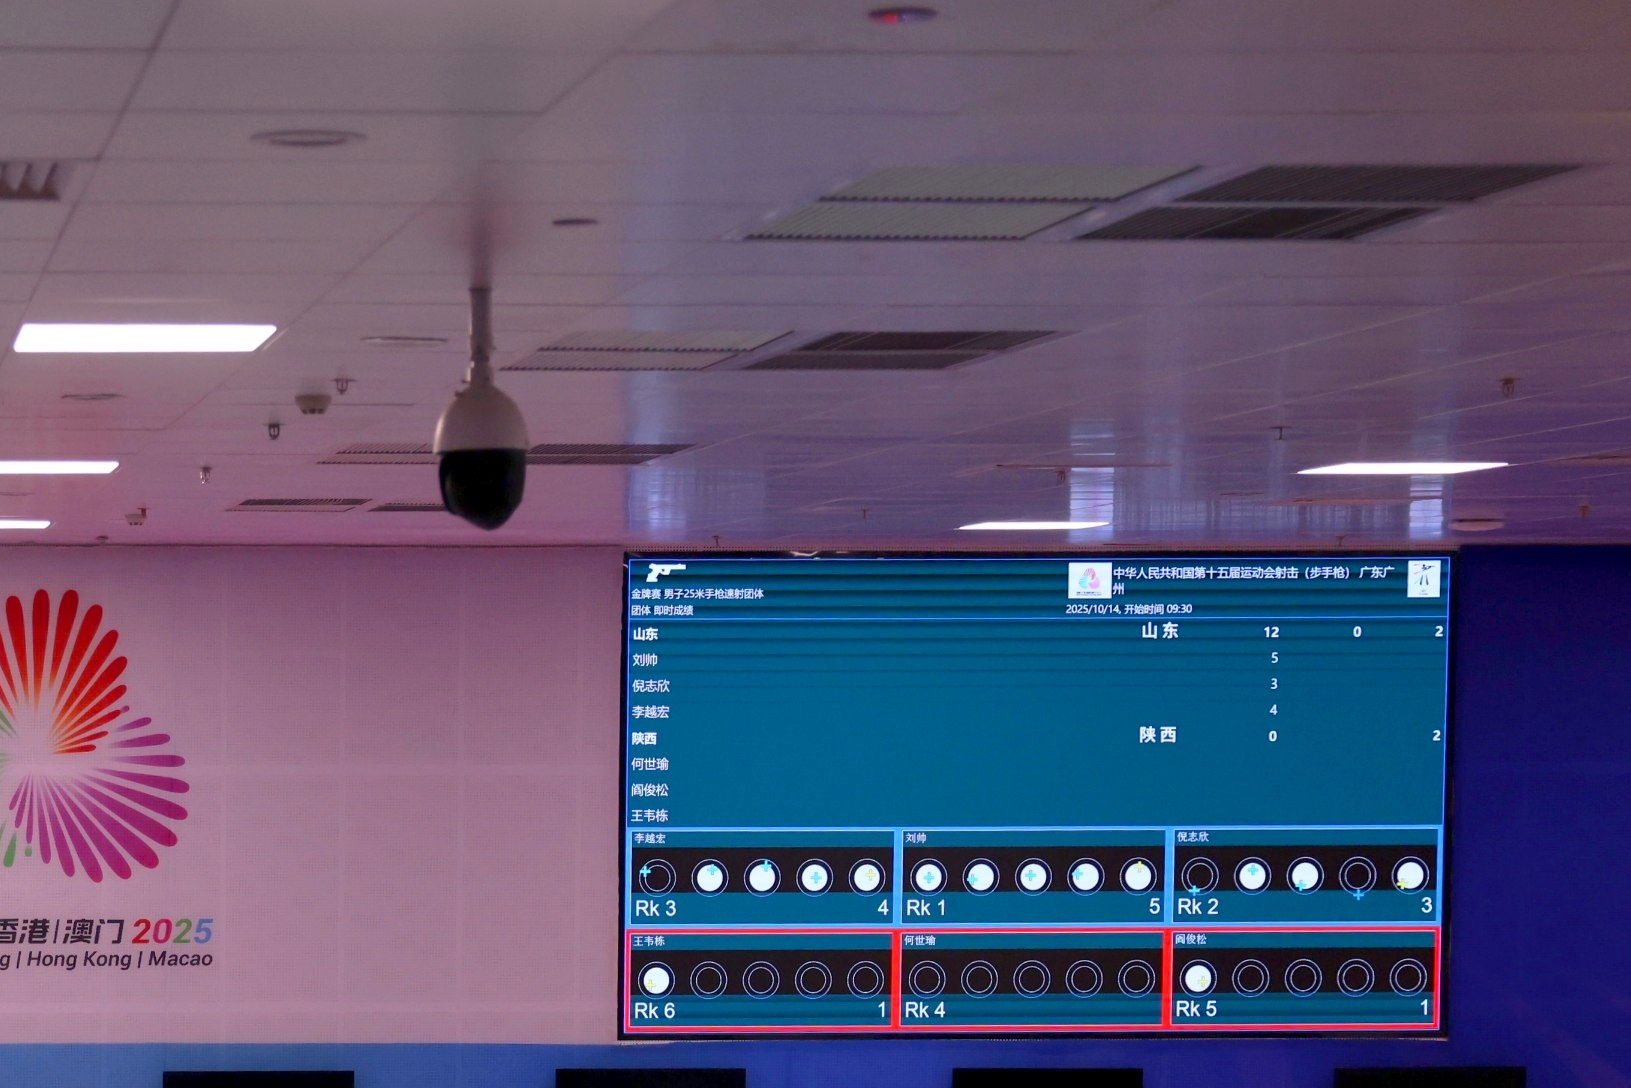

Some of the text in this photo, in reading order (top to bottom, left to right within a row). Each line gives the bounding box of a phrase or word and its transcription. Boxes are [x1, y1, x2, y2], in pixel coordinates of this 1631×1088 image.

[1358, 565, 1395, 579] 广东广
[631, 588, 765, 600] 金牌赛 男子25米手枪速射团体
[1112, 582, 1125, 595] 州
[630, 604, 694, 616] 团体 即时成绩
[1065, 603, 1193, 615] 2025/10/14, 开始时间 09:30
[633, 626, 659, 642] 山东
[1263, 626, 1280, 638] 12
[1352, 625, 1362, 638] 0
[1434, 625, 1444, 638] 2
[632, 652, 658, 667] 刘帅
[1271, 651, 1279, 664] 5
[632, 679, 671, 693] 倪志欣
[1270, 677, 1278, 690] 3
[631, 704, 670, 719] 李越宏
[1269, 703, 1278, 716] 4
[631, 731, 658, 746] 陕西
[1268, 730, 1278, 742] 0
[1432, 729, 1441, 742] 2
[630, 756, 670, 771] 何世瑜
[631, 782, 669, 797] 阎俊松
[630, 808, 669, 823] 王韦栋
[634, 833, 665, 844] 李越宏
[906, 833, 926, 843] 刘帅
[1178, 831, 1209, 842] 倪志欣
[635, 899, 677, 917] Rk 3
[877, 898, 890, 916] 4
[906, 898, 945, 916] Rk 1
[1149, 897, 1161, 915] 5
[1177, 897, 1219, 915] Rk 2
[1421, 896, 1433, 914] 3
[132, 919, 214, 944] 2025
[634, 936, 665, 946] 王韦栋
[27, 951, 77, 970] Hong
[84, 951, 132, 970] Kong
[148, 951, 213, 966] Macao
[634, 1001, 676, 1019] Rk 6
[878, 1000, 886, 1018] 1
[905, 1001, 946, 1019] Rk 4
[1175, 1000, 1217, 1017] Rk 5
[1420, 998, 1428, 1016] 1
